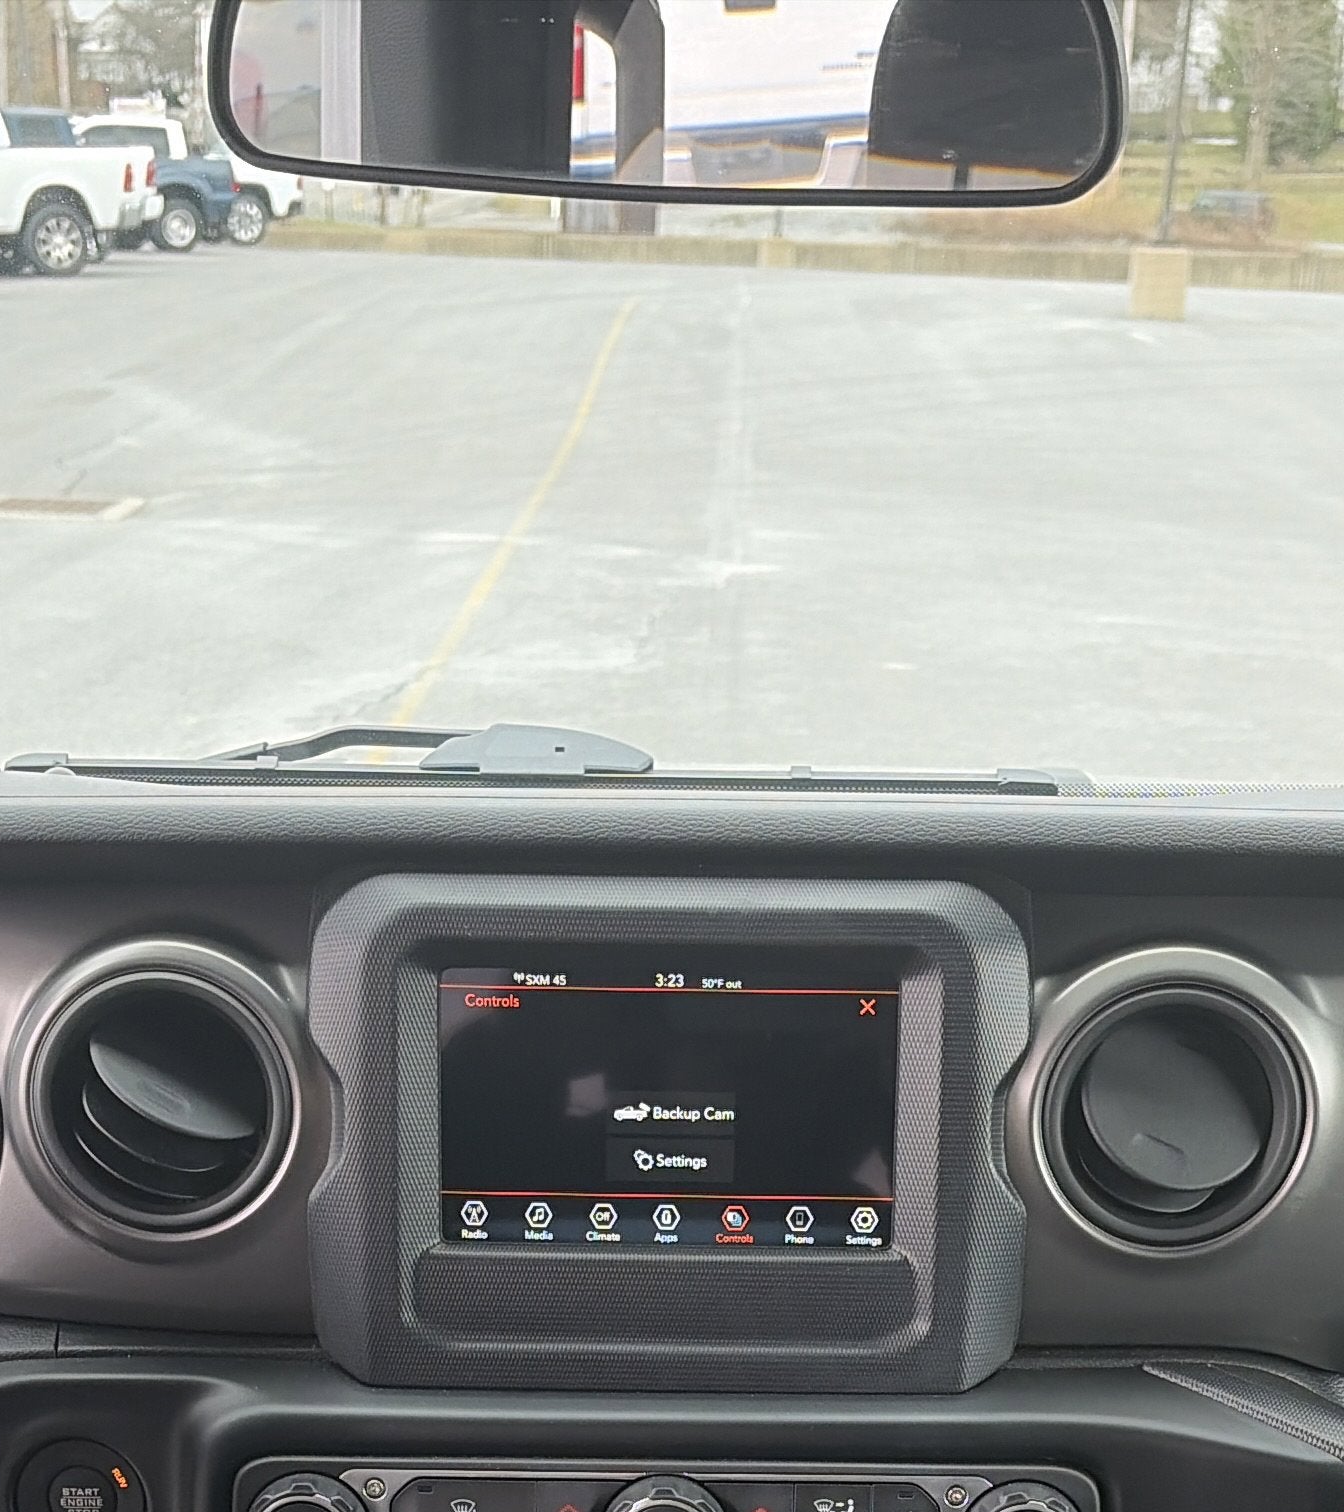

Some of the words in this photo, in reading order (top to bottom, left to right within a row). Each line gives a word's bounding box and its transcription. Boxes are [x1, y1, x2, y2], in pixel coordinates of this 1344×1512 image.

[525, 973, 551, 987] SXM
[553, 974, 567, 986] 45
[655, 973, 685, 988] 3:23
[701, 978, 724, 989] 50°F
[725, 979, 743, 989] out
[464, 993, 521, 1008] Controls
[652, 1105, 701, 1122] Backup
[703, 1106, 735, 1121] Cam
[656, 1153, 708, 1170] Settings
[461, 1229, 488, 1240] Radio
[524, 1230, 554, 1241] Media
[585, 1231, 621, 1242] Climate
[653, 1232, 678, 1244] Apps
[715, 1233, 754, 1244] Controls
[784, 1234, 815, 1245] Phone
[845, 1234, 883, 1246] Settings
[111, 1467, 129, 1489] RUN
[61, 1487, 100, 1496] START
[60, 1498, 104, 1507] ENGINE
